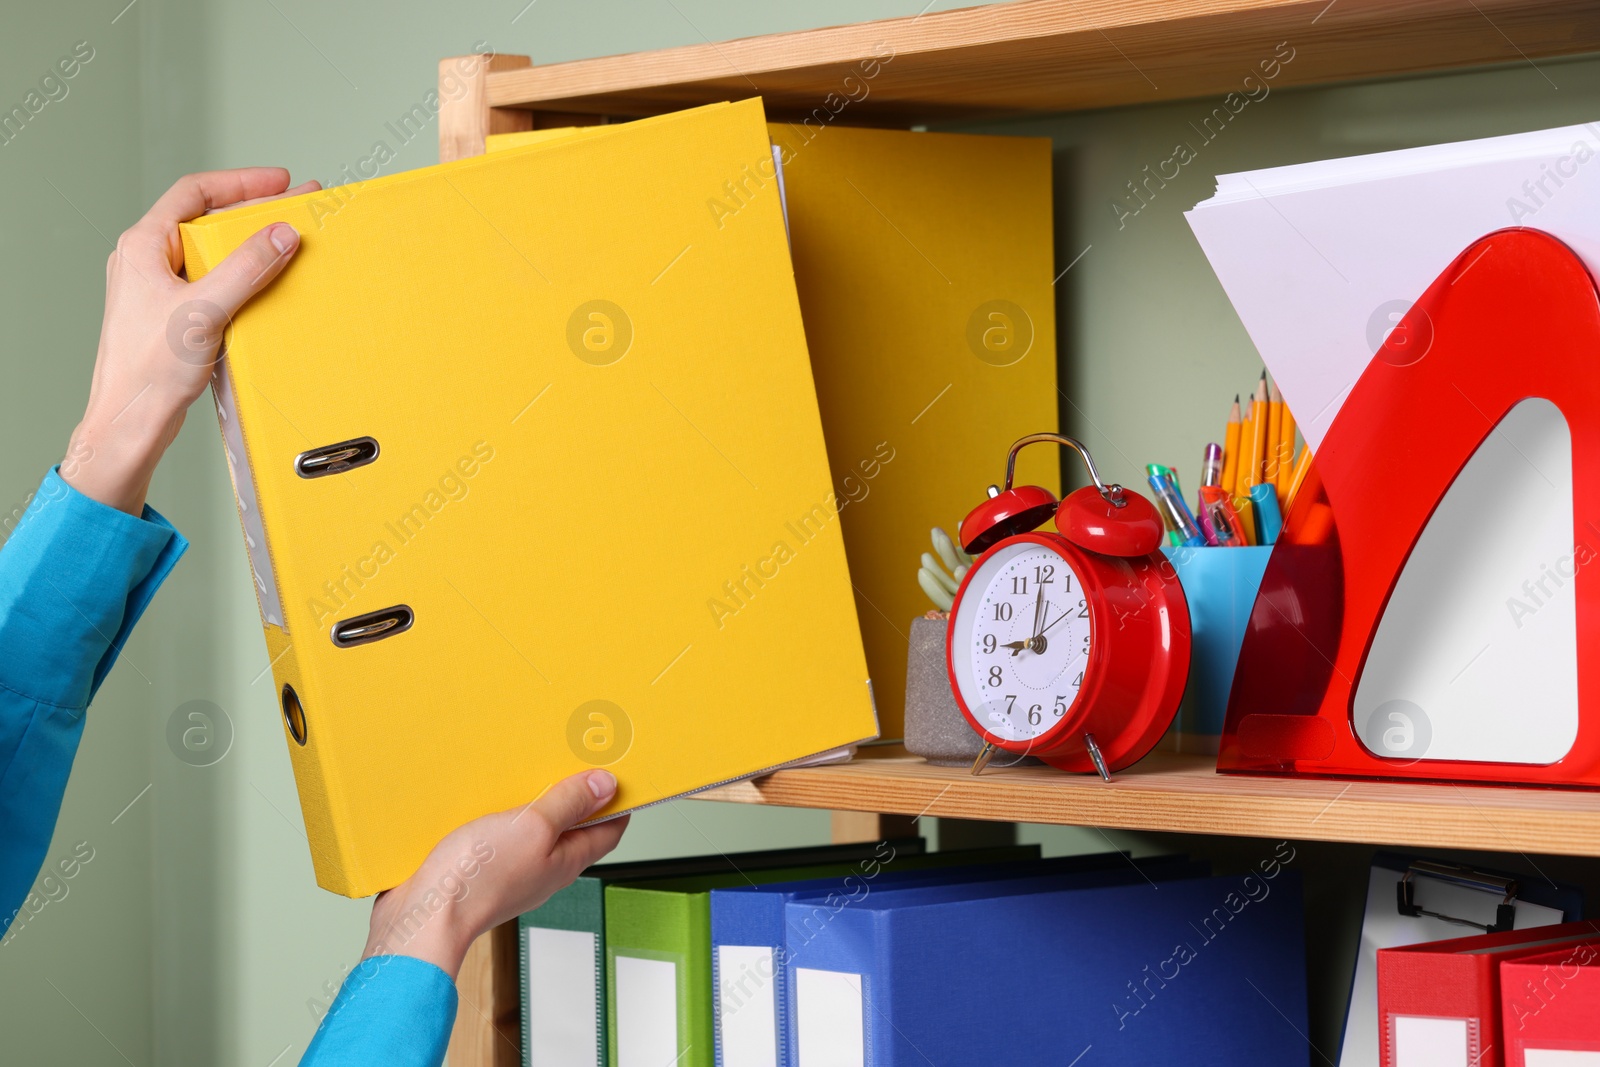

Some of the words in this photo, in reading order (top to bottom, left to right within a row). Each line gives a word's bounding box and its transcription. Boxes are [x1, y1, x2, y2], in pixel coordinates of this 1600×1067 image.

[1033, 565, 1055, 584] 12
[1064, 574, 1072, 593] 1
[1010, 576, 1029, 595] 11
[992, 602, 1013, 621] 10
[1078, 599, 1090, 619] 2
[983, 634, 997, 654] 9
[988, 665, 1002, 687] 8
[1071, 671, 1084, 691] 4
[1004, 695, 1017, 715] 7
[1028, 704, 1042, 726] 6
[1053, 695, 1067, 716] 5
